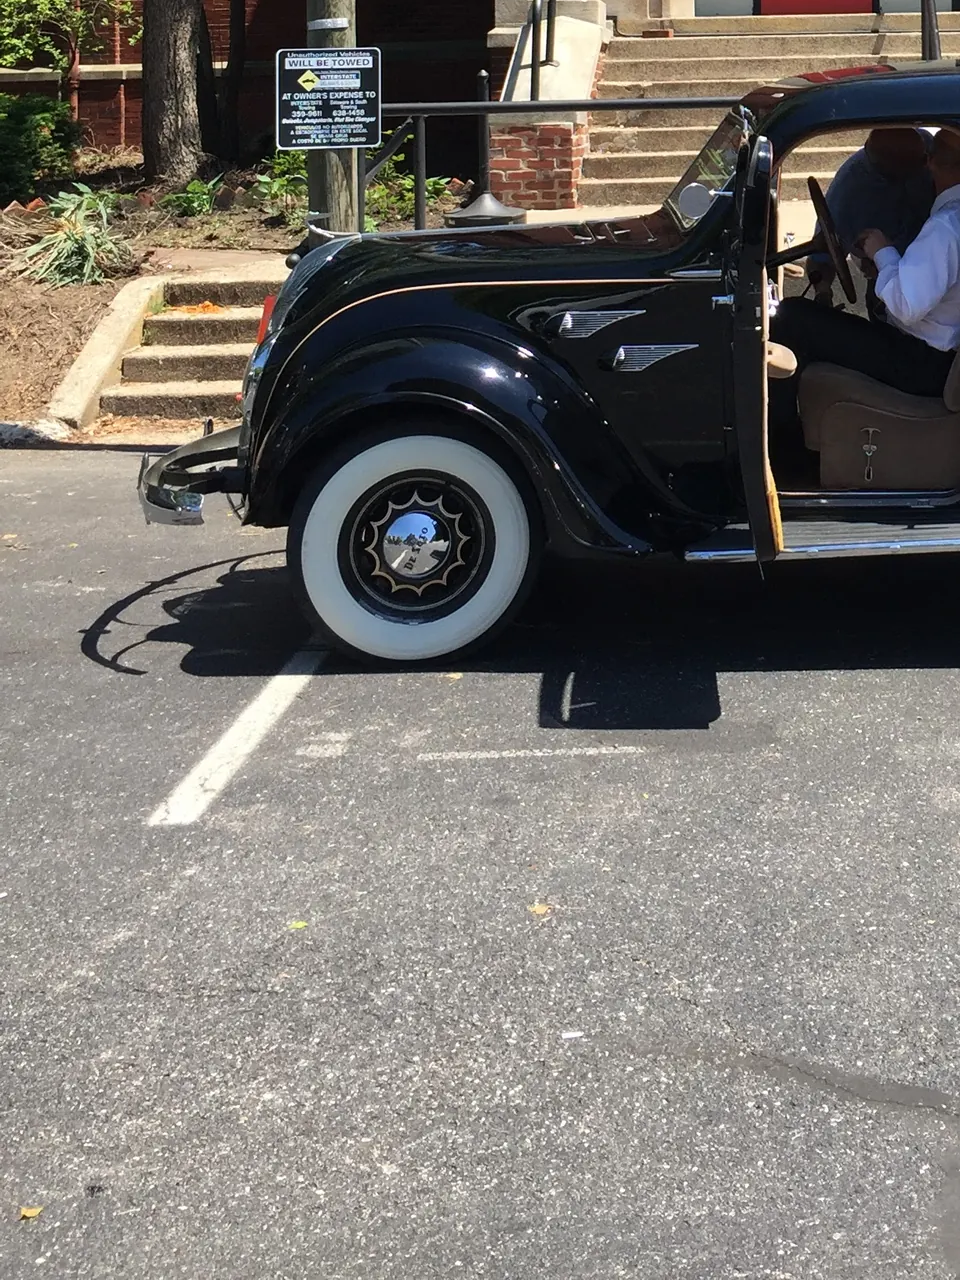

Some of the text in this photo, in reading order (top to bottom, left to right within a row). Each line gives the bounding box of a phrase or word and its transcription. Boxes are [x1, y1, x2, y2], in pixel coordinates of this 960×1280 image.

[288, 58, 370, 67] WILL BE TOWED
[293, 92, 328, 100] OWNER'S
[329, 91, 364, 99] EXPENSE
